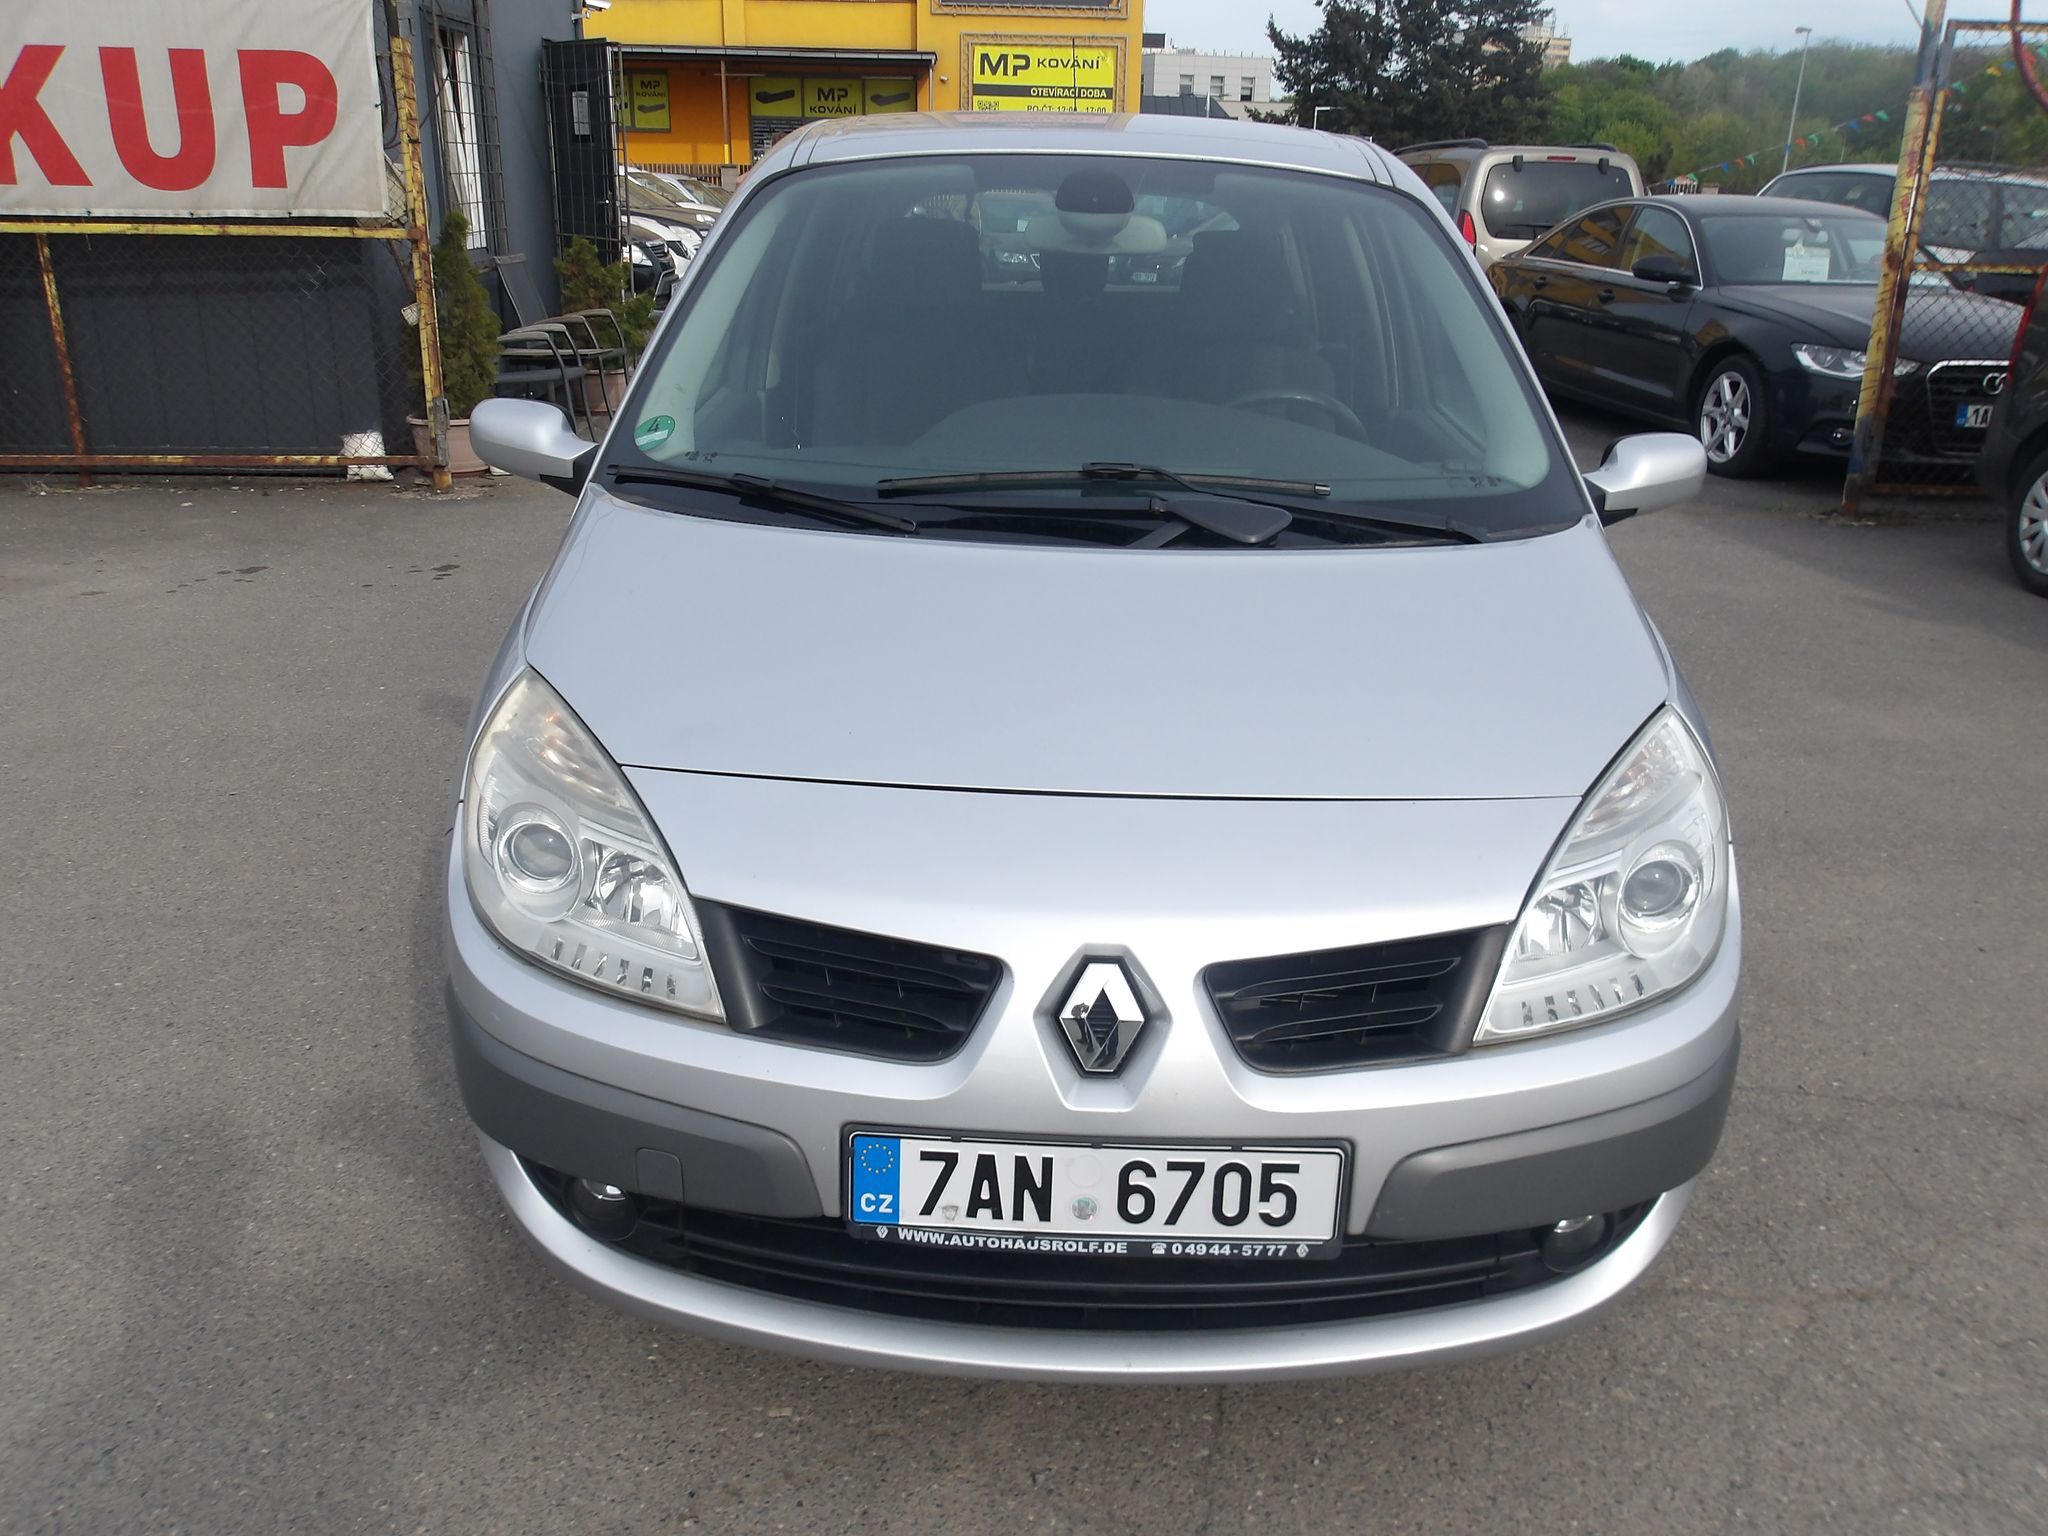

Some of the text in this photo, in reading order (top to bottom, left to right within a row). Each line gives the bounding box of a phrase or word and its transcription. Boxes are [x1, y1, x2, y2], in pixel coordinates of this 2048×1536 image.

[979, 53, 1100, 77] MP KOVÁNÍ
[640, 80, 661, 90] MP
[817, 87, 849, 102] MP
[1030, 86, 1107, 99] OTEVÍRACÍ DOBA
[0, 44, 338, 191] KUP
[809, 105, 857, 114] KOVÁNÍ
[647, 416, 660, 432] 4
[918, 1150, 1300, 1228] 7AN 6705
[860, 1192, 893, 1214] CZ
[897, 1226, 1288, 1258] WWW.AUTOHAUSROLF.DE 04944-5777
